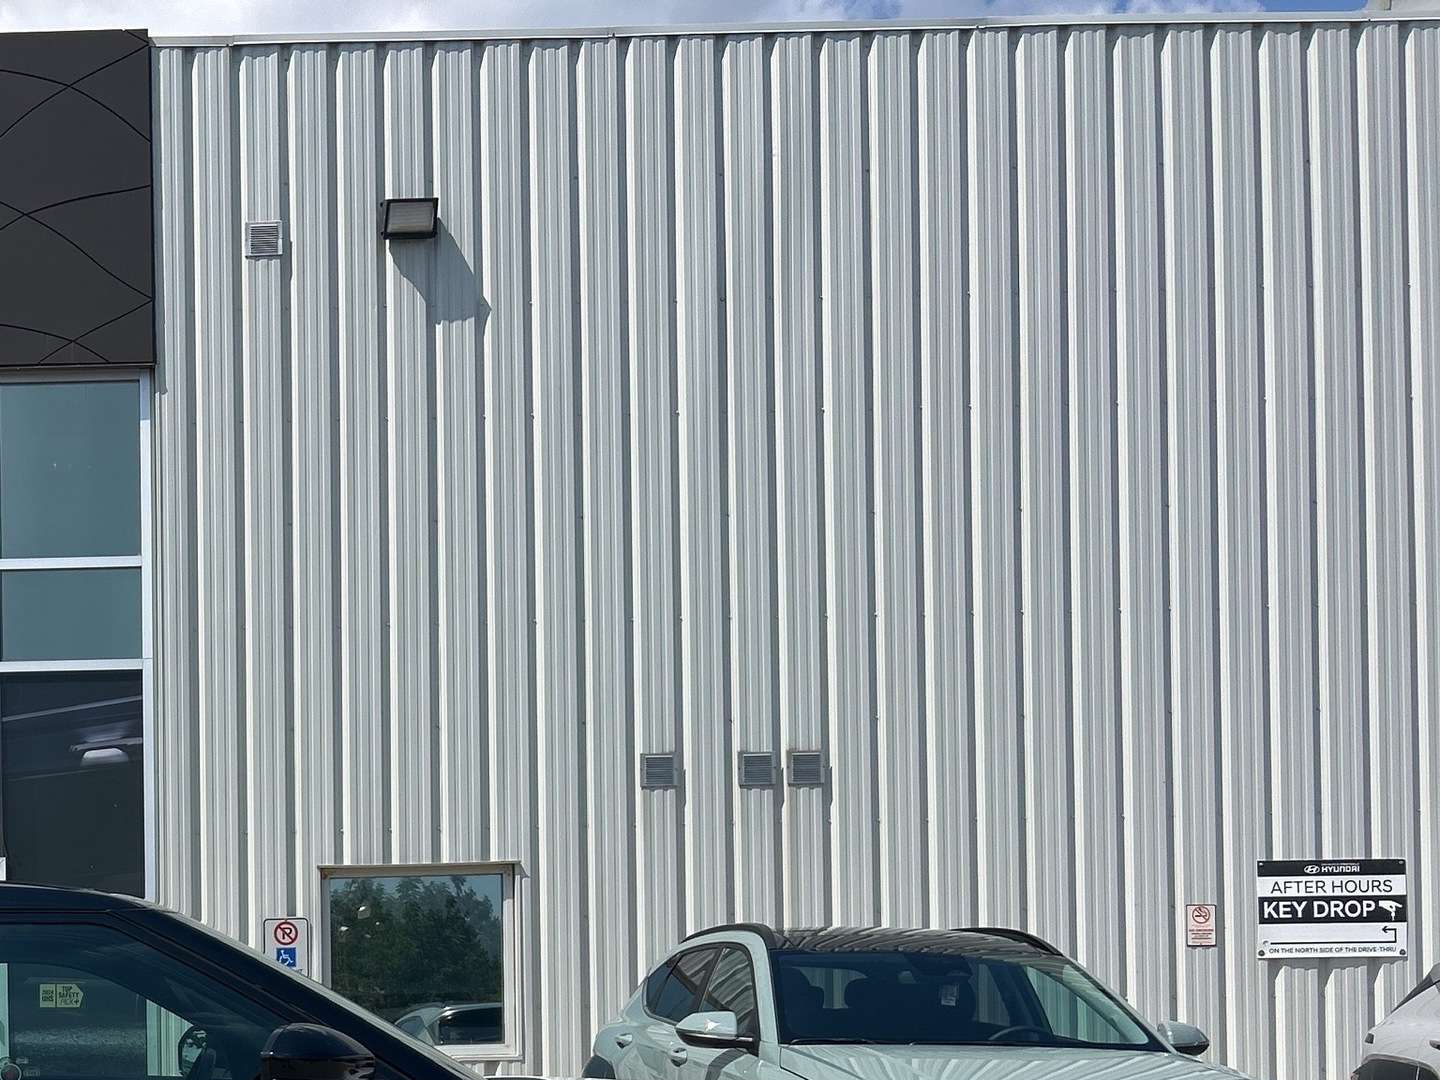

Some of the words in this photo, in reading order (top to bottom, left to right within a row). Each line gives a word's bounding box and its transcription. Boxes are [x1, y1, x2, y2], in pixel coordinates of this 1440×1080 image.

[1321, 865, 1360, 873] HYUNDAI
[1270, 880, 1327, 895] AFTER
[1331, 879, 1393, 894] HOURS
[1263, 900, 1308, 919] KEY
[1313, 899, 1376, 918] DROP
